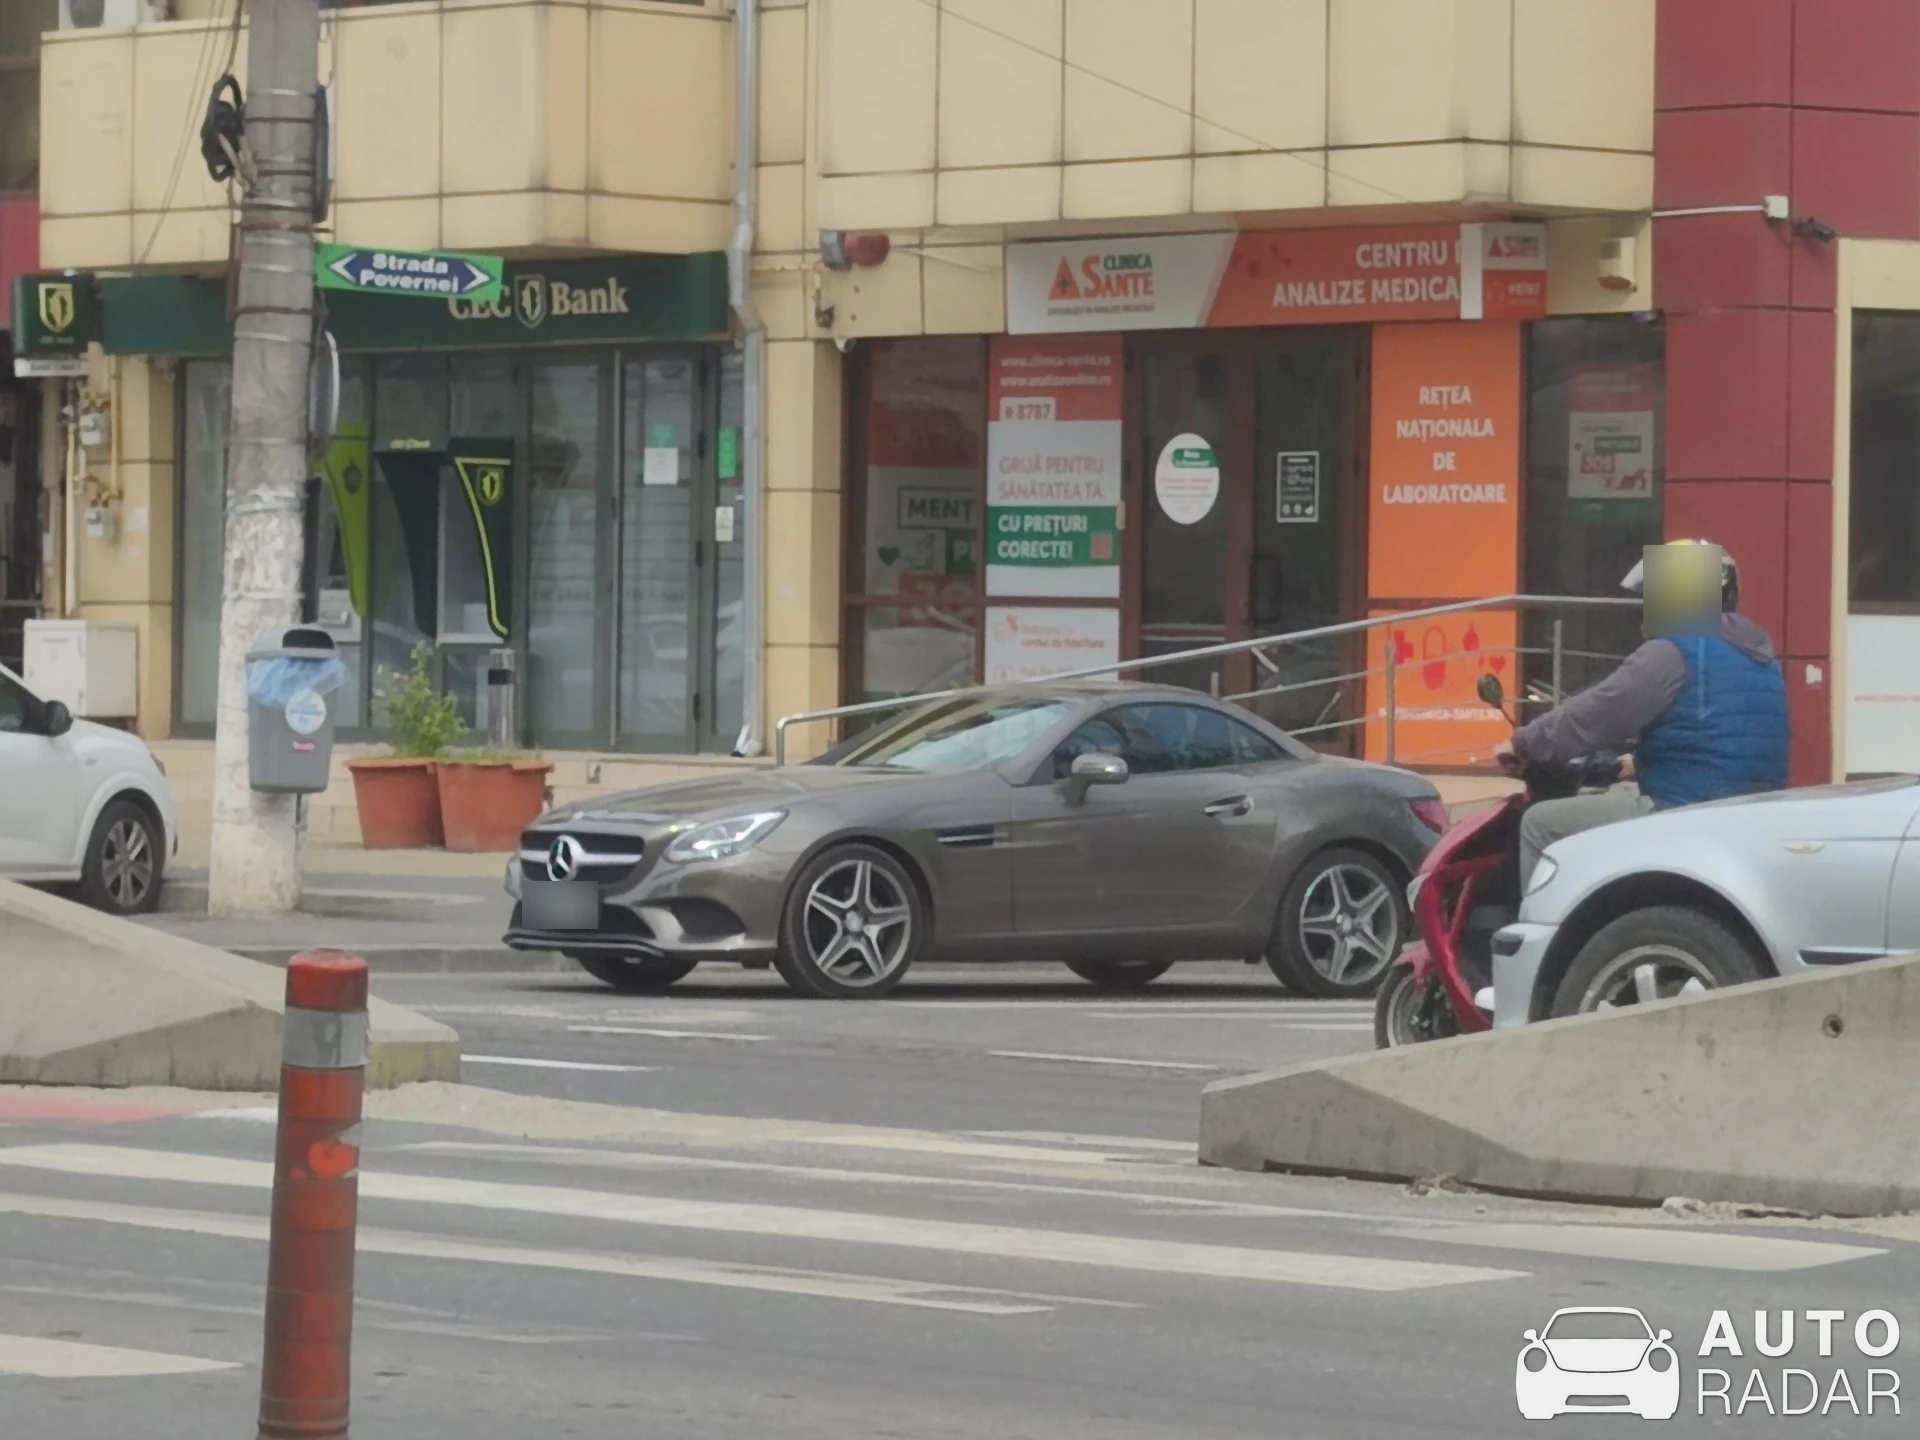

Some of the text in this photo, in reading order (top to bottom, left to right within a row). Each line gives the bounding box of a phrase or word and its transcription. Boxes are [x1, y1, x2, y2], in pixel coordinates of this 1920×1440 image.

[373, 253, 448, 274] Strada
[1103, 253, 1153, 271] CLINICA
[1355, 239, 1448, 269] CENTRU
[360, 269, 459, 293] Povernei
[1082, 255, 1154, 298] SANTE
[551, 277, 629, 316] Bank
[1272, 280, 1366, 308] ANALIZE
[1046, 455, 1104, 474] PENTRU
[1432, 451, 1456, 471] DE
[1383, 483, 1506, 505] LABORATOARE
[998, 514, 1020, 533] CU
